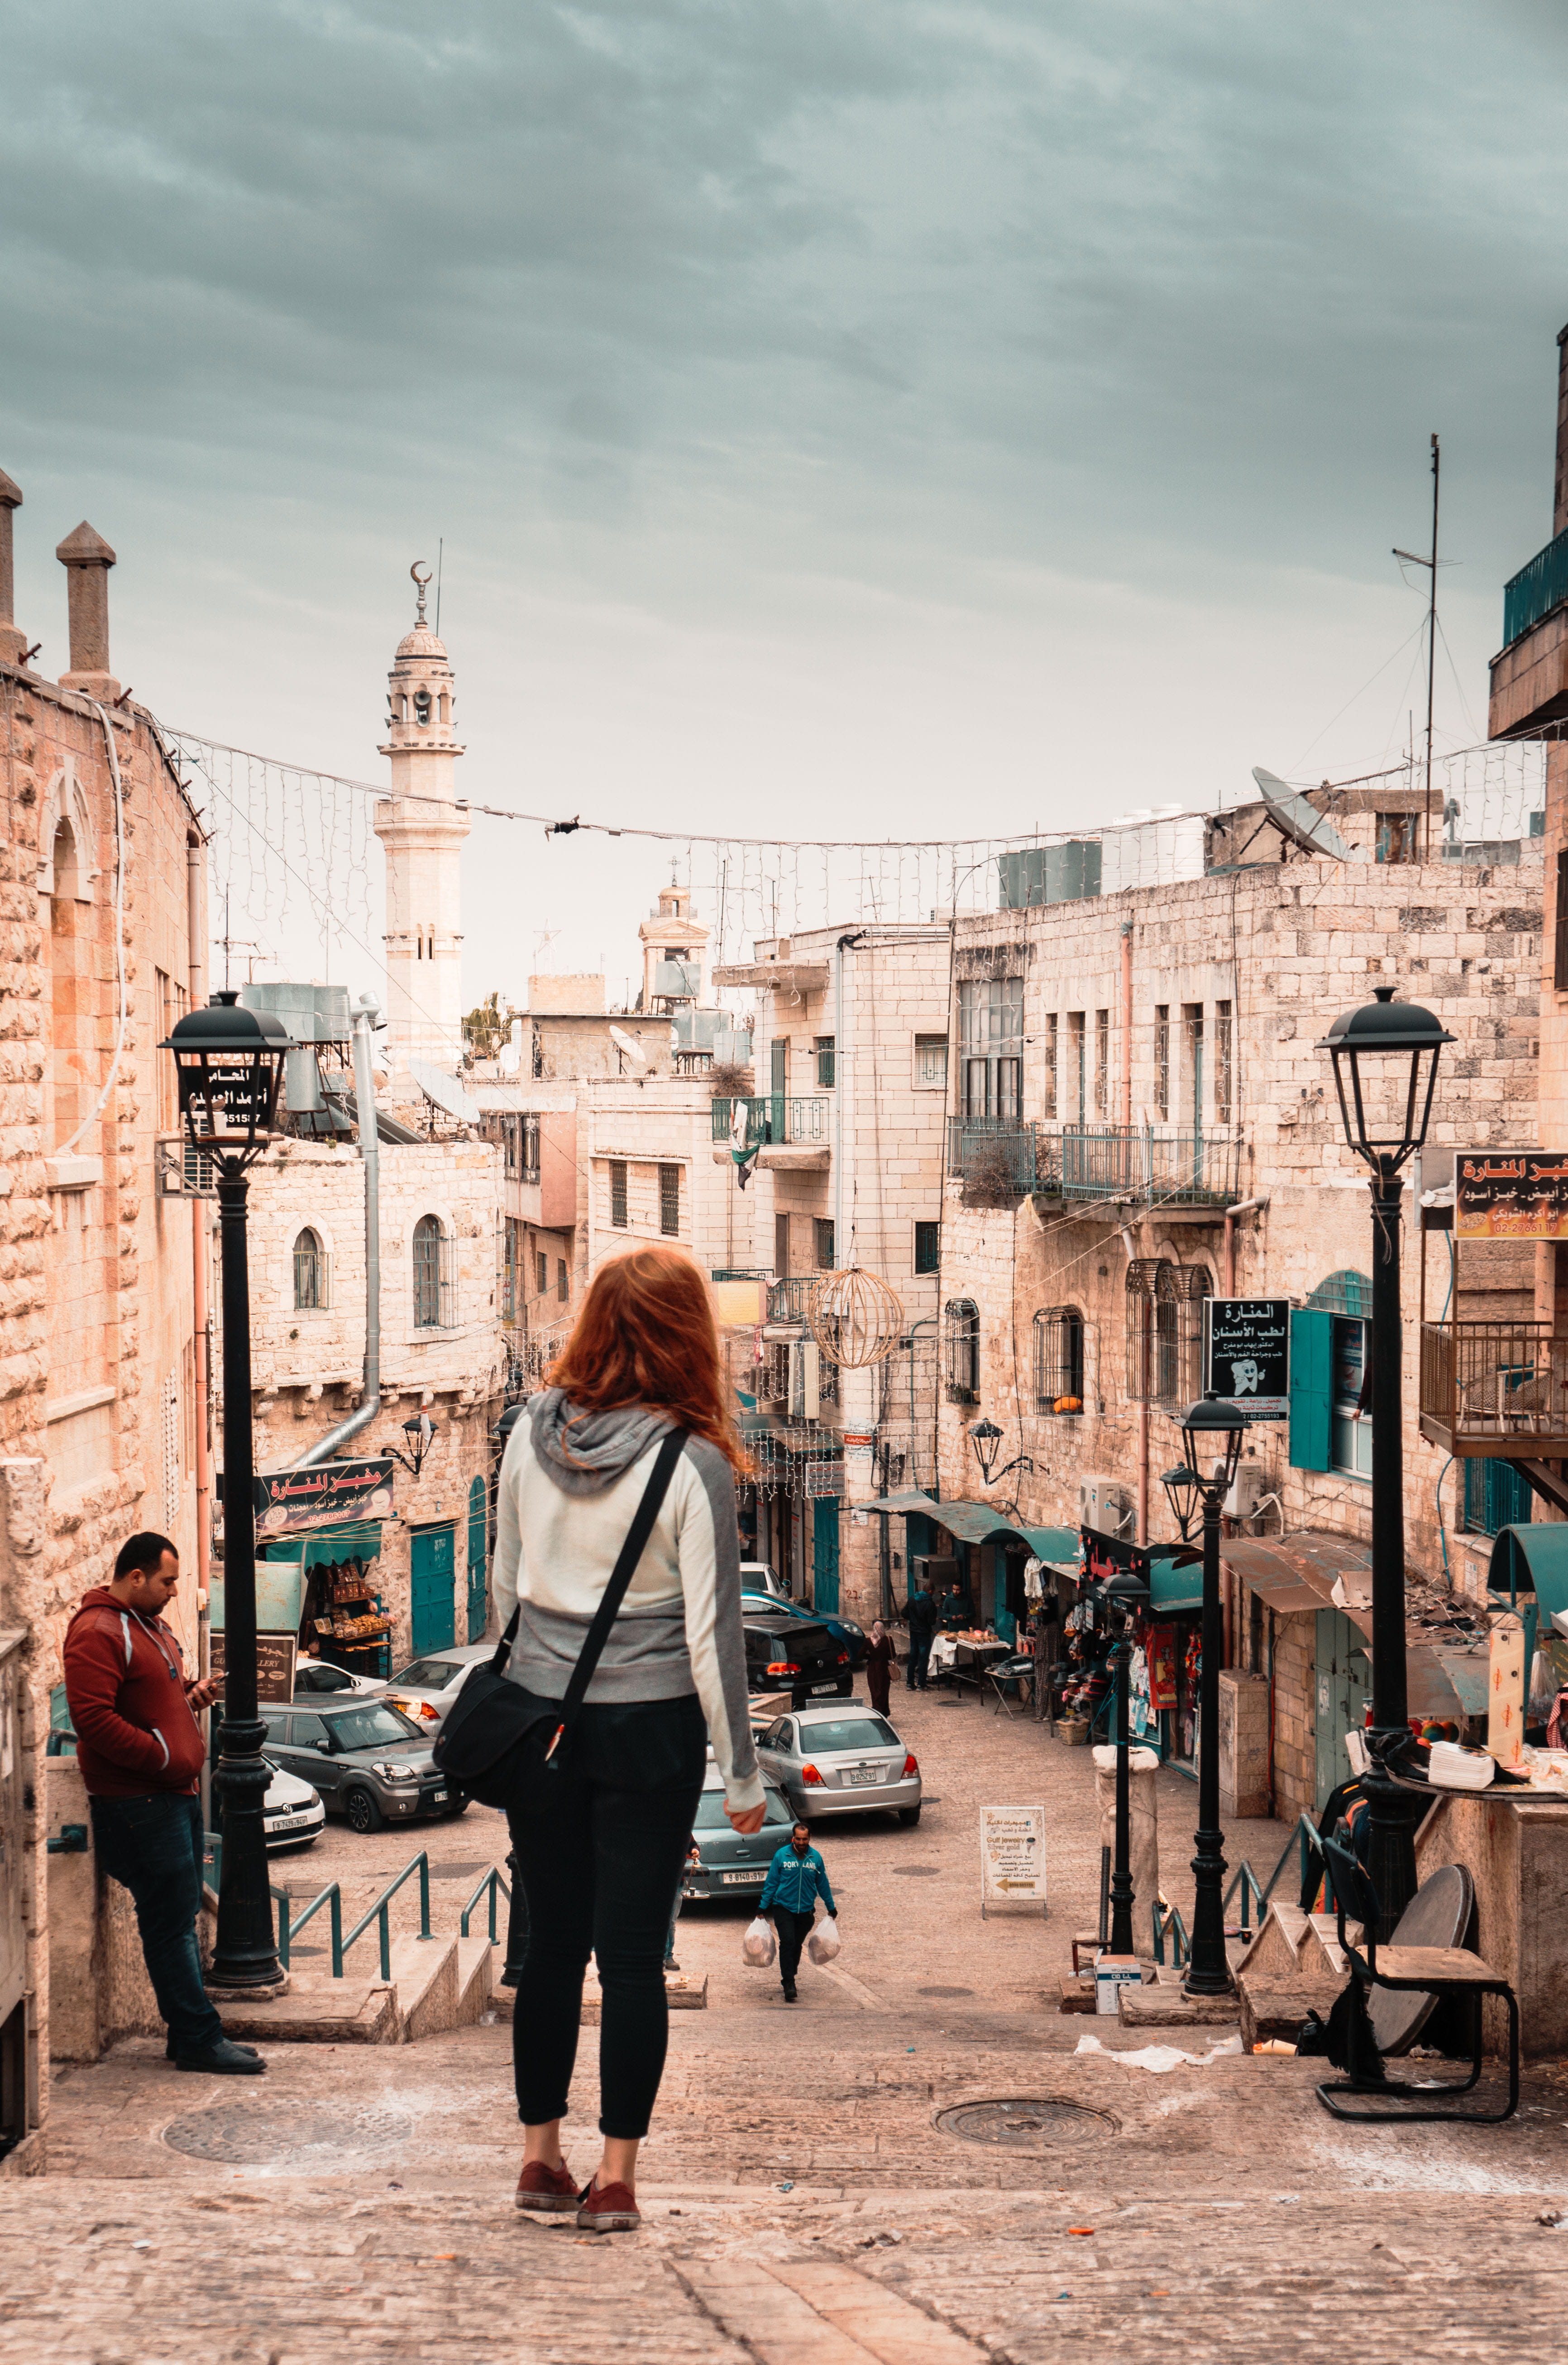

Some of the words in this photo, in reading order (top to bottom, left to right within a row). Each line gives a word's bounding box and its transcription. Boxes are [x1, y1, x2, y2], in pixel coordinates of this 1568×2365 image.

[1463, 1158, 1526, 1182] المنارة
[1529, 1159, 1568, 1182] خبز
[1464, 1186, 1491, 1202] أسود
[1493, 1187, 1518, 1202] خبز
[1527, 1186, 1558, 1202] أبيض
[1528, 1207, 1545, 1220] أكرم
[1546, 1207, 1558, 1220] أبو
[1495, 1223, 1557, 1233] 02-2766117
[1225, 1303, 1274, 1322] المنارة
[1212, 1321, 1254, 1340] الأسنان
[1257, 1326, 1285, 1340] لطب
[271, 1473, 328, 1500] المنارة
[330, 1467, 382, 1493] مخبز
[326, 1498, 338, 1509] خبز
[308, 1510, 351, 1522] 02-2766117
